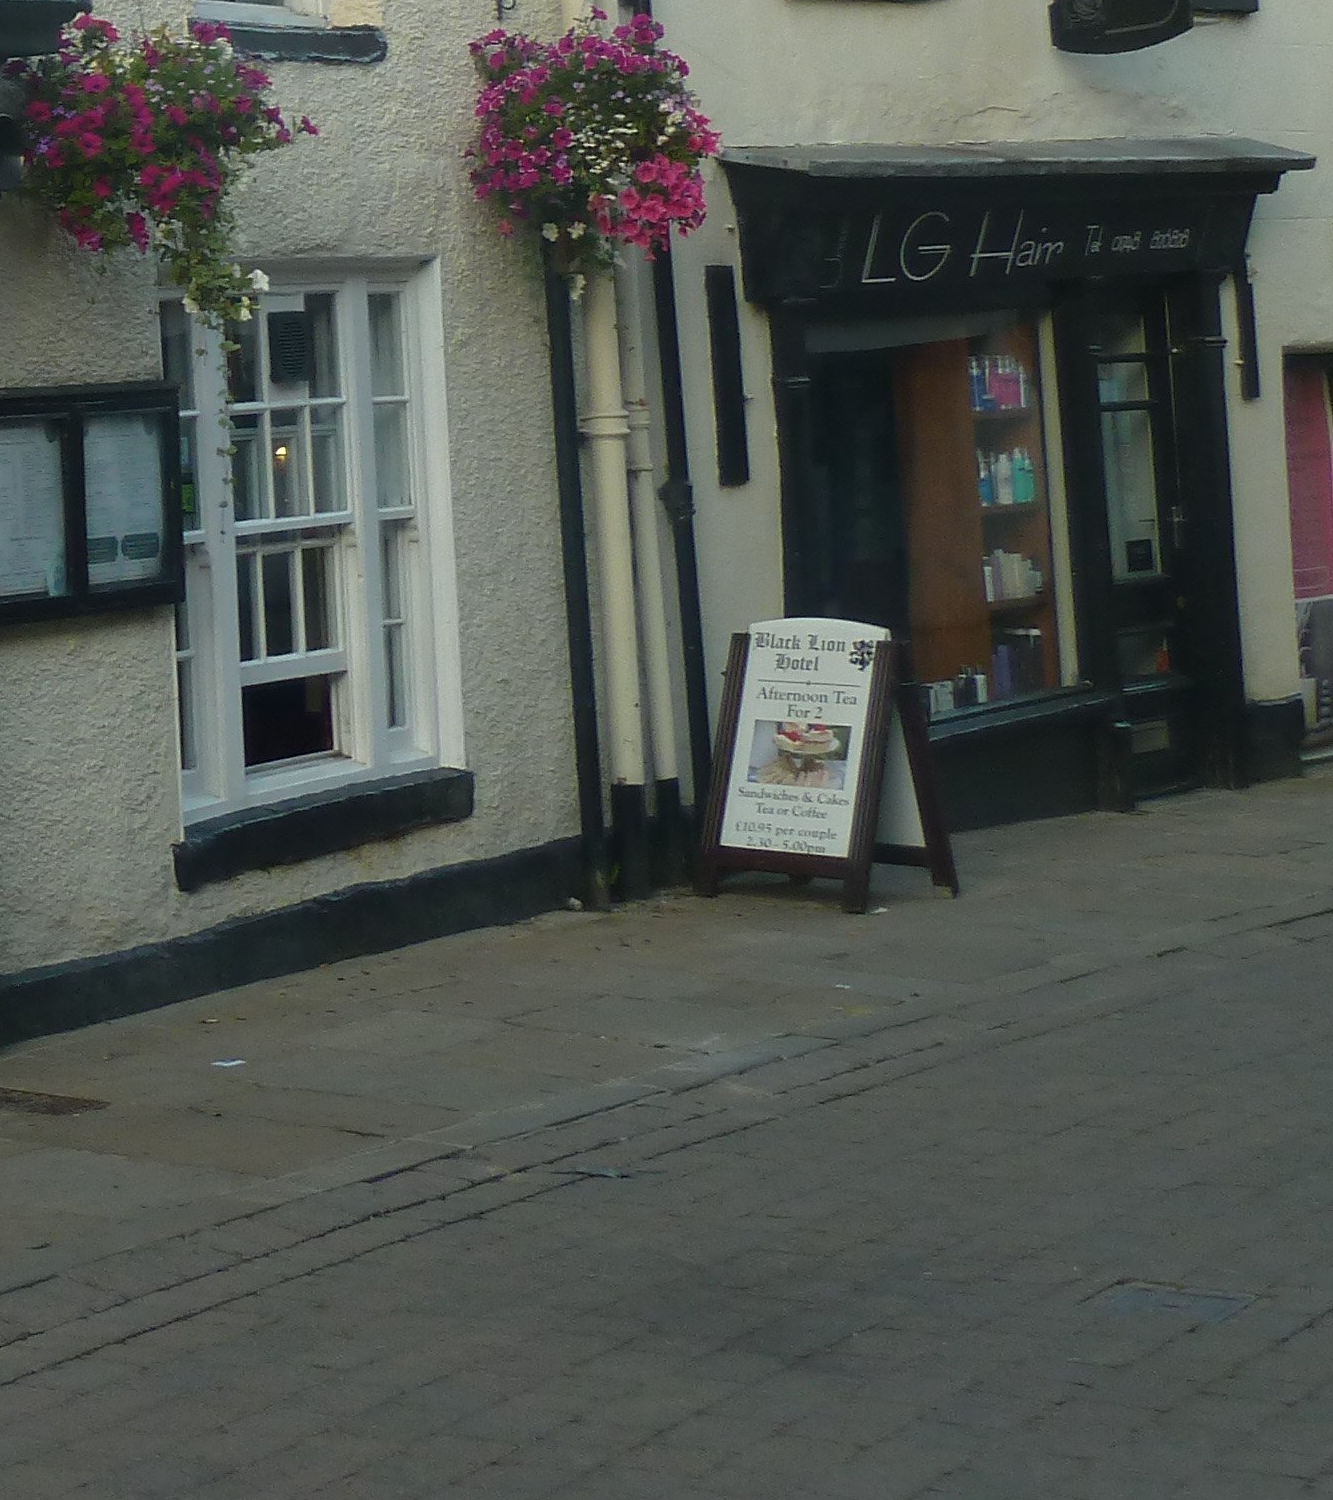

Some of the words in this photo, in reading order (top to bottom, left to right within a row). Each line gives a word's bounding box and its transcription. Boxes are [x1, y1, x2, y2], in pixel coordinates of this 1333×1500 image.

[860, 210, 951, 284] LG
[969, 208, 1064, 277] Hair
[755, 632, 801, 650] Black
[808, 633, 846, 652] Lion
[774, 653, 819, 672] Hotel
[756, 686, 828, 703] Afternoon
[833, 690, 858, 705] Tea
[786, 704, 810, 718] For
[814, 706, 823, 719] 2
[801, 791, 814, 803] &
[817, 793, 850, 806] Cakes
[755, 802, 774, 815] Tea
[776, 806, 789, 815] or
[792, 805, 828, 819] Coffee
[775, 826, 794, 836] per
[797, 827, 838, 840] couple
